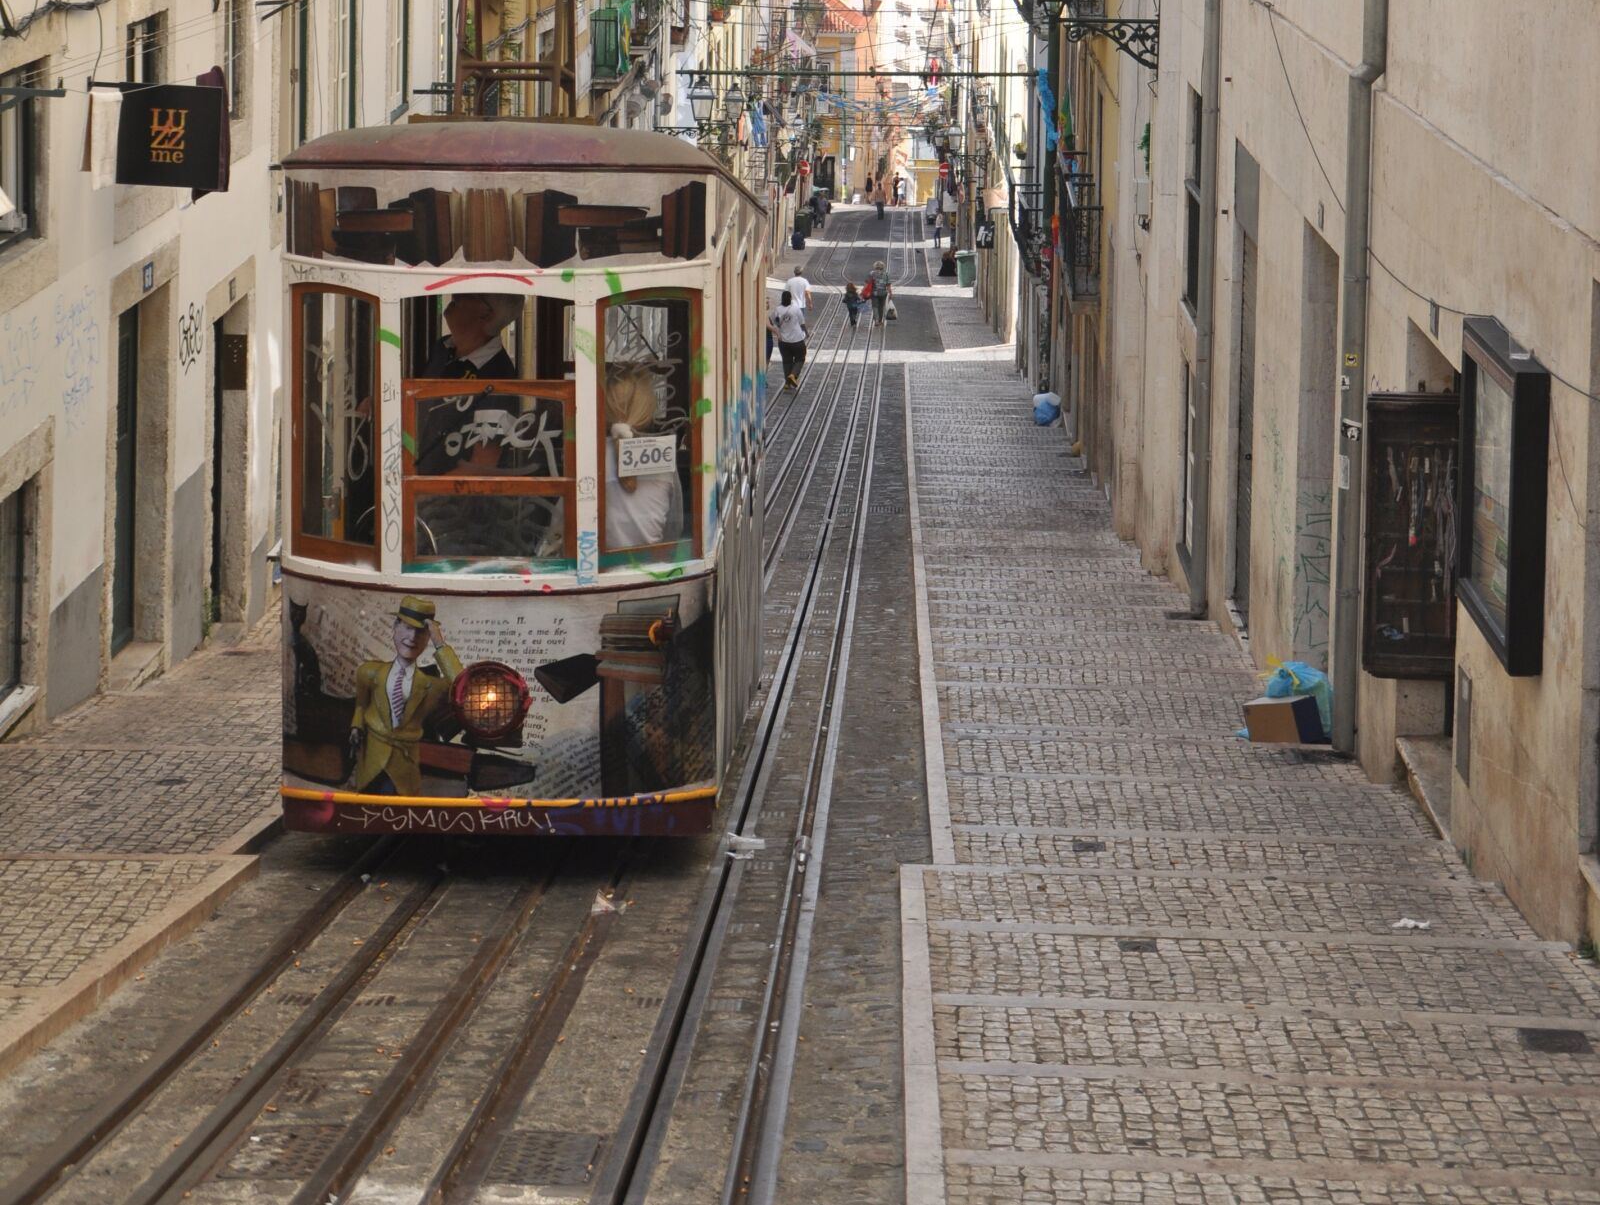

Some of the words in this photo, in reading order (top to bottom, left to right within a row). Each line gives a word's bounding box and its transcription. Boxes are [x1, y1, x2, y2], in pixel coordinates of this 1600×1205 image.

[150, 126, 185, 149] ZZ
[150, 150, 184, 163] me
[622, 446, 673, 468] 3,60€
